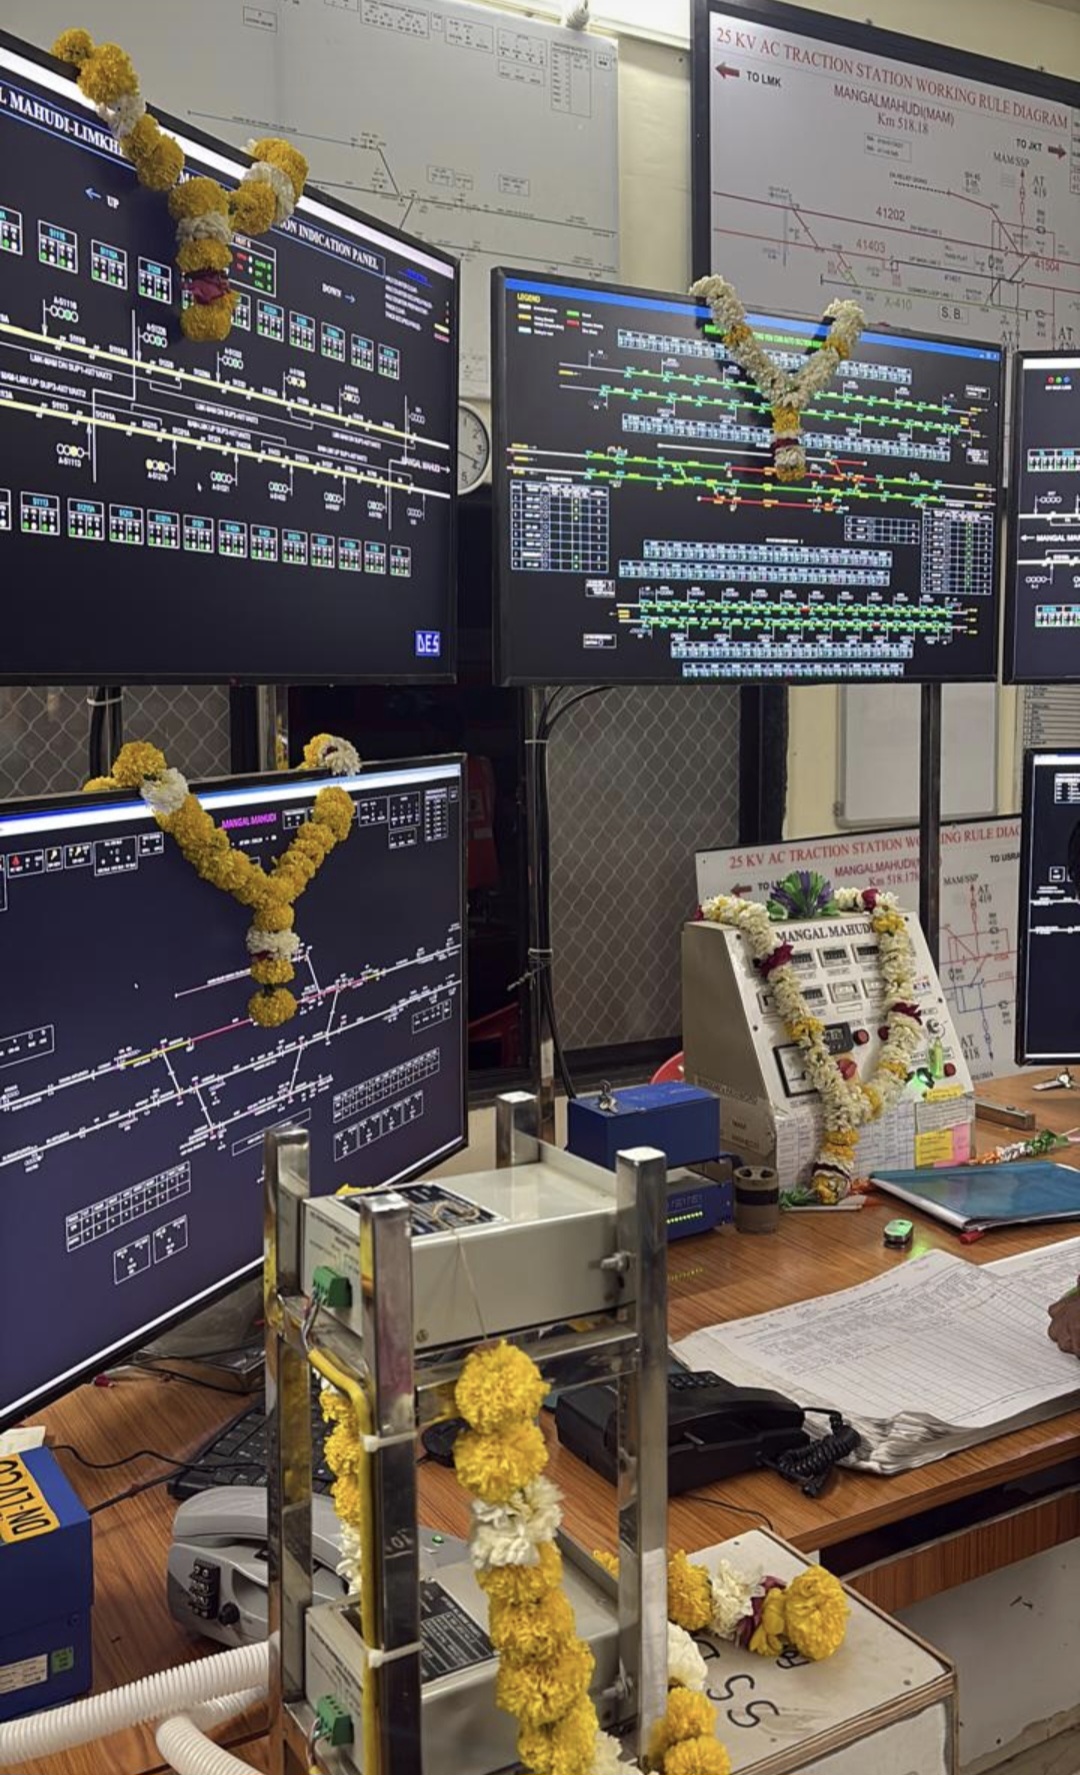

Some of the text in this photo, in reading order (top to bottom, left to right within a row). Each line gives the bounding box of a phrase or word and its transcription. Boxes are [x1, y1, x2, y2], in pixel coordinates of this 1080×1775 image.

[717, 28, 1068, 129] 25 KV AC TRACTION STATION WORKING RULE DIAGRAM
[747, 70, 782, 88] TO LMK
[834, 84, 955, 127] MANGALMAHUDI(MAM)
[9, 90, 124, 156] MAHUDI-LIMKH
[877, 113, 929, 134] Km 518.18
[1016, 138, 1043, 152] TO JKT
[106, 195, 120, 209] UP
[875, 206, 906, 222] 41202
[299, 223, 351, 258] INDICATION
[351, 247, 379, 271] PANEL
[856, 238, 886, 254] 41403
[1035, 258, 1060, 273] 41504
[322, 283, 342, 298] DOWN
[1058, 326, 1074, 341] AT
[730, 856, 743, 869] 25
[745, 853, 765, 867] KV
[768, 852, 785, 865] AC
[788, 842, 852, 863] TRACTION
[852, 837, 903, 856] STATION
[963, 827, 994, 842] RULE
[989, 855, 1000, 863] TO
[868, 875, 885, 887] Km
[776, 926, 826, 943] MANGAL
